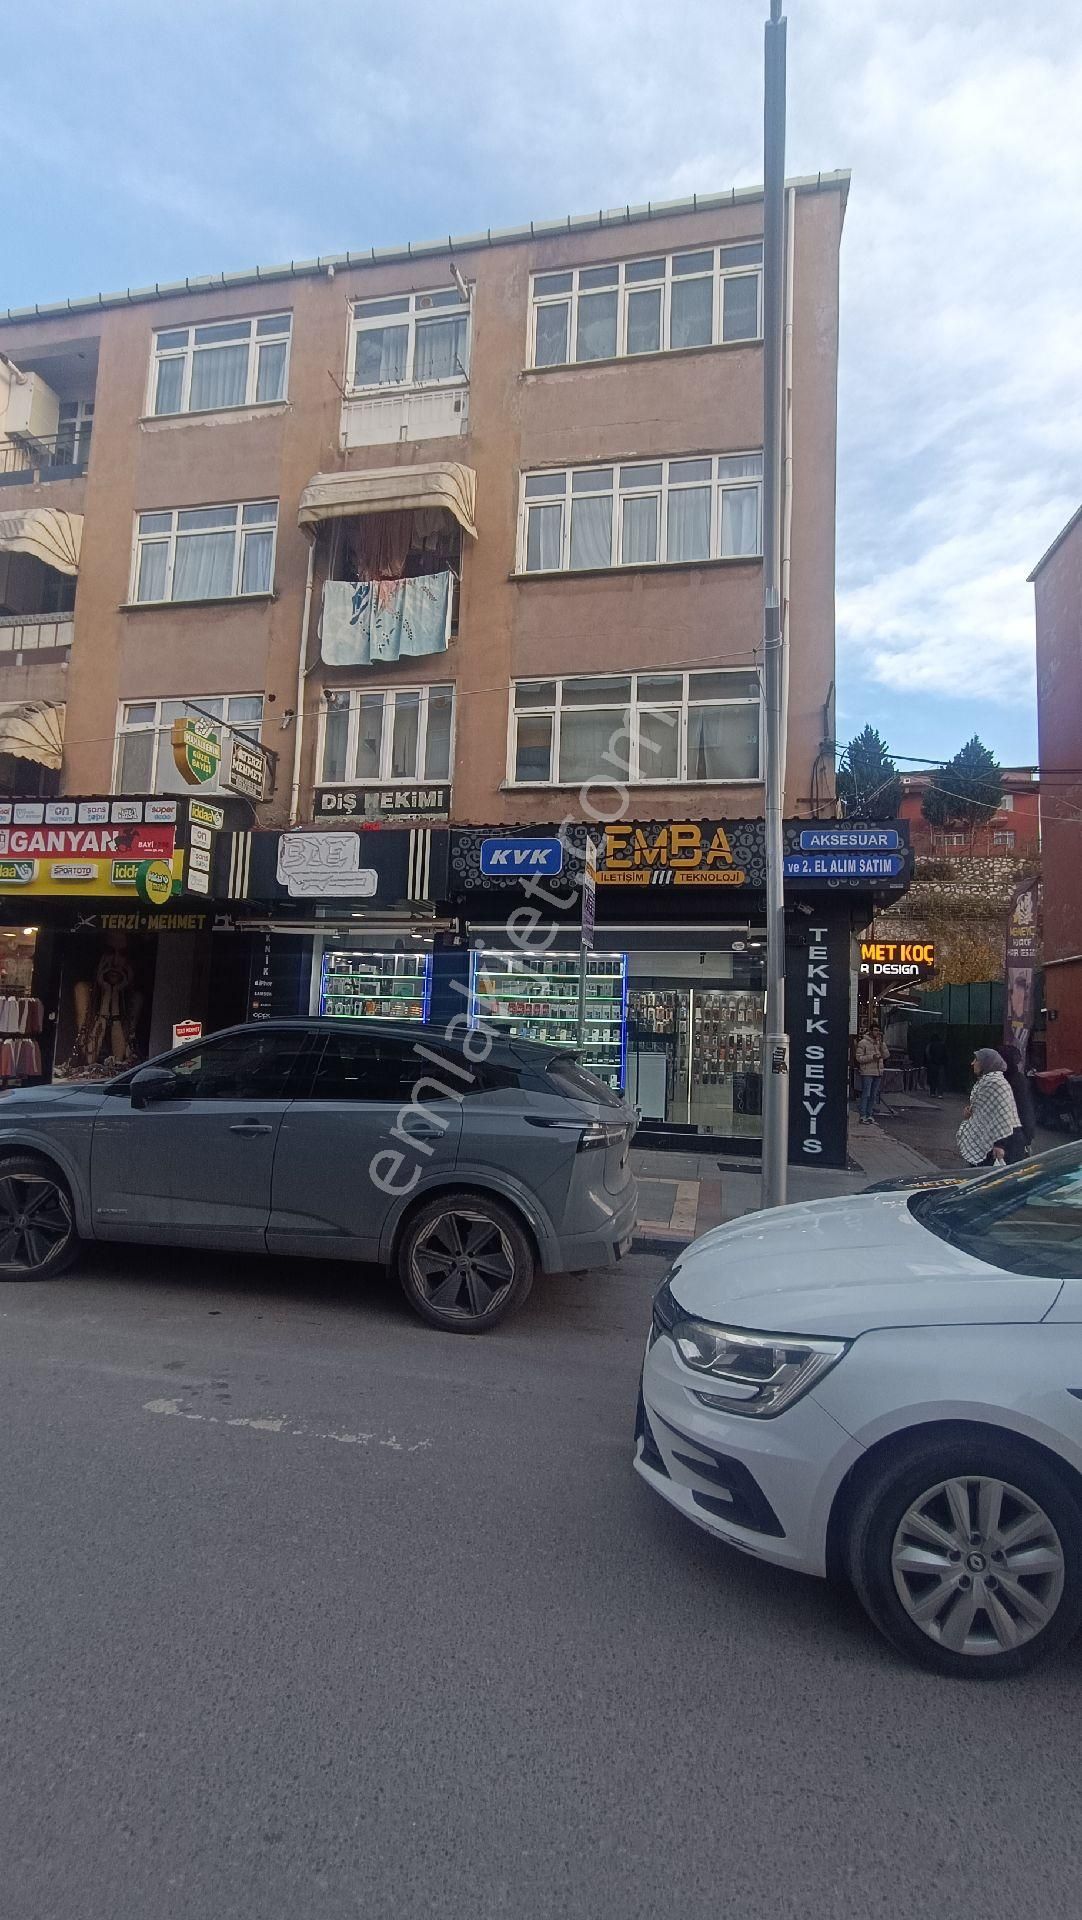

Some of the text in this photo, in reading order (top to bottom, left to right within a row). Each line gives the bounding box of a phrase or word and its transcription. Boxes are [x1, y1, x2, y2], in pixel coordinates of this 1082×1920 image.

[231, 758, 264, 783] MEHMET
[321, 790, 443, 814] DİŞ HEKİMİ
[10, 831, 119, 852] GANYAN
[604, 825, 733, 868] EMBA
[810, 834, 888, 846] AKSESUAR
[489, 848, 553, 865] KVK
[788, 863, 800, 872] ve
[802, 860, 811, 872] 2.
[815, 860, 827, 872] EL
[830, 859, 856, 872] ALIM
[860, 858, 892, 873] SATIM
[600, 871, 740, 883] İLETİŞİM TEKNOLOJİ
[147, 914, 207, 929] MEHMET
[860, 943, 934, 966] MET KOÇ
[860, 964, 869, 974] R
[802, 928, 830, 1154] TEKNİK SERVİS
